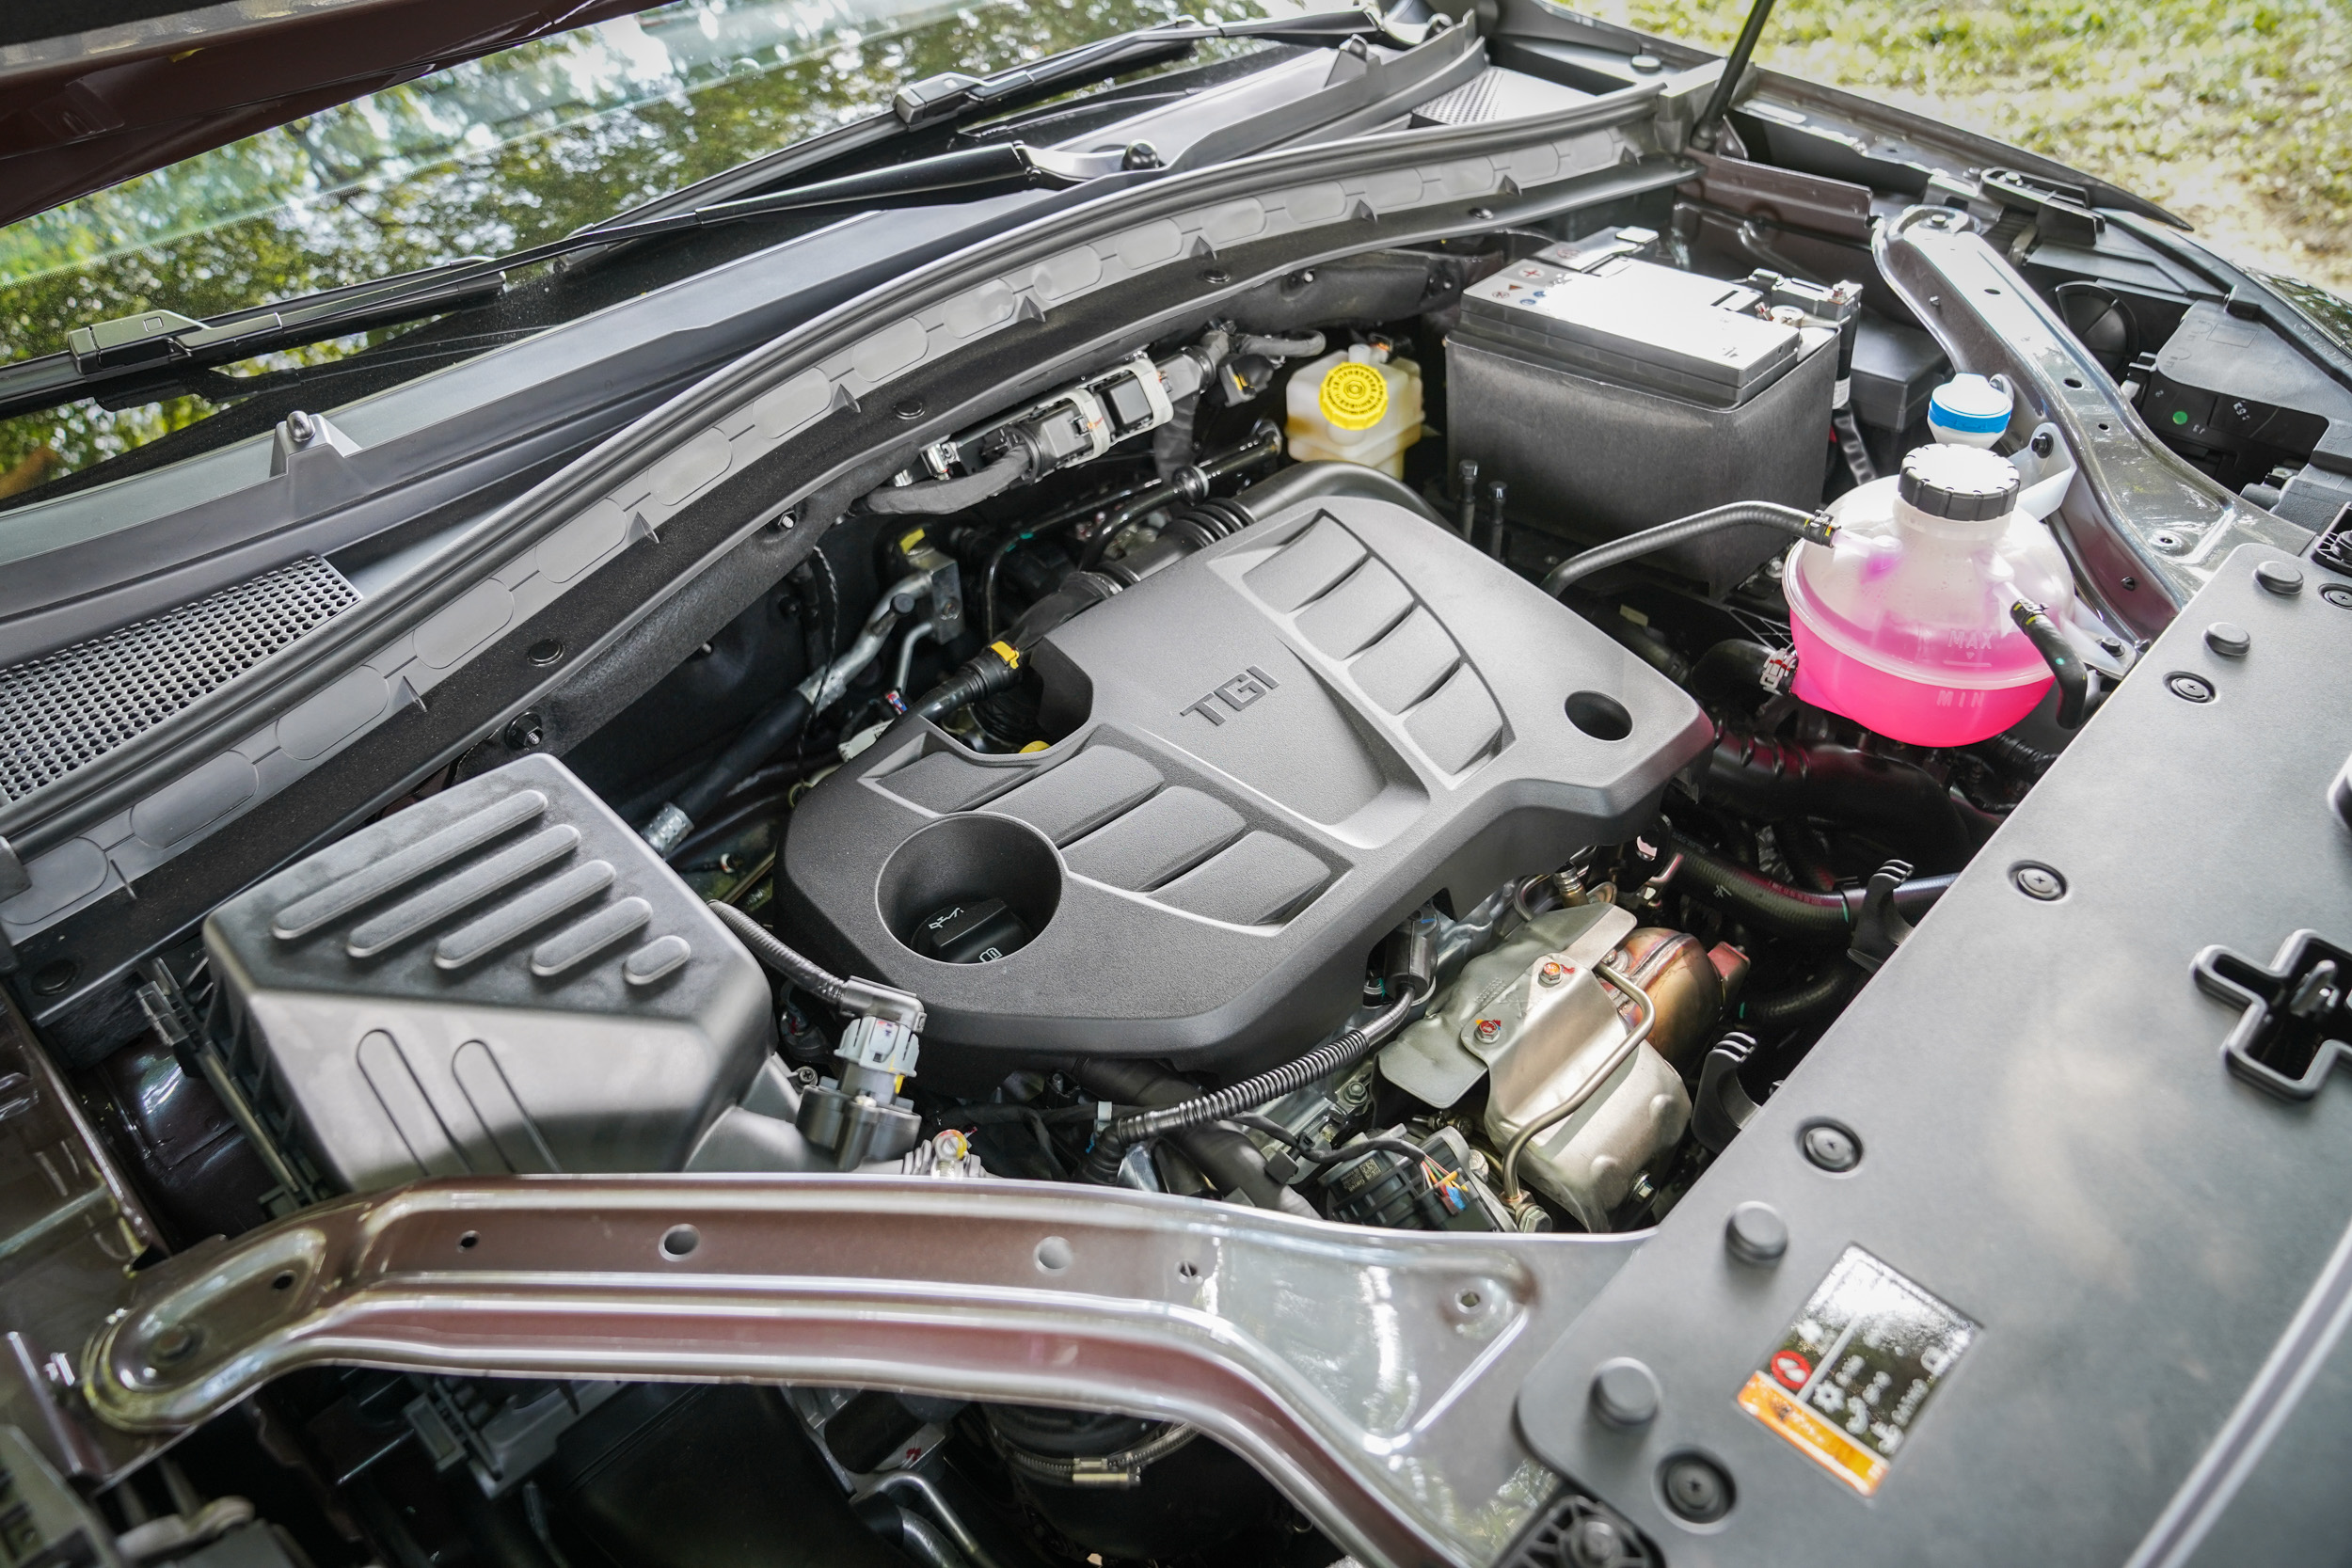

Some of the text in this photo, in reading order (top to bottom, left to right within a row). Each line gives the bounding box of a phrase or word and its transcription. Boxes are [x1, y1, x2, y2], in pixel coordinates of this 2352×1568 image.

[1947, 630, 1992, 649] MAX
[1180, 664, 1280, 726] TGI
[1936, 690, 1985, 708] MIN
